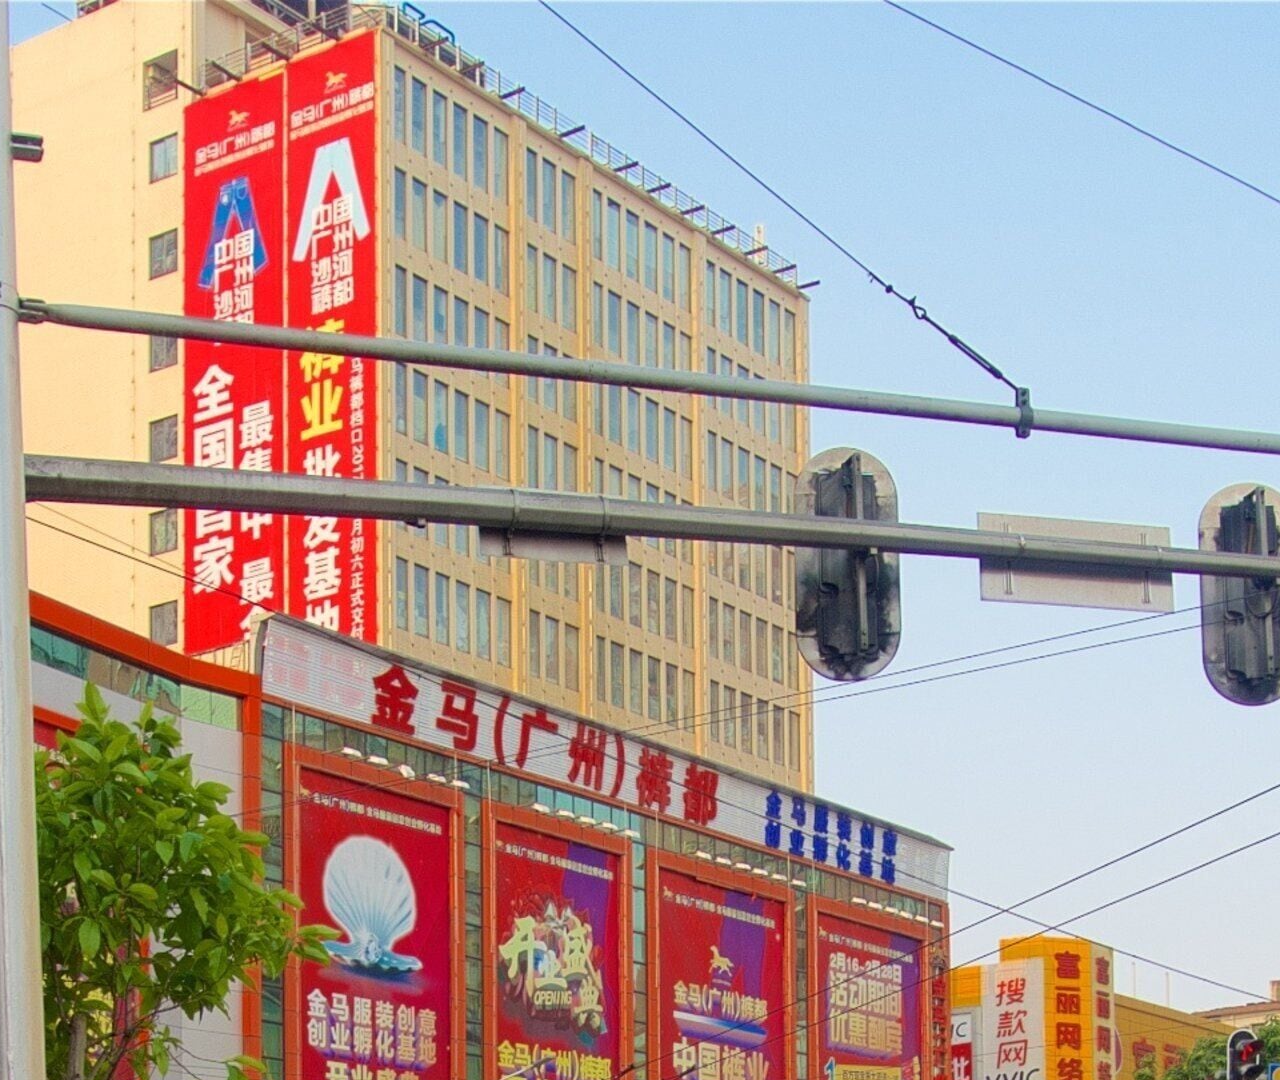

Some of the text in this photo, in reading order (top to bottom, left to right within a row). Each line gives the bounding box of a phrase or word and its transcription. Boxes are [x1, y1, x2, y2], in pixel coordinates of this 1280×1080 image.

[312, 193, 353, 229] 中国
[214, 228, 254, 264] 中国
[312, 225, 353, 260] 广州
[214, 257, 254, 293] 广州
[312, 249, 353, 287] 沙河
[312, 278, 353, 315] 裤都
[371, 663, 720, 827] 金马（广州）裤都
[307, 988, 438, 1036] 金马服装创意
[533, 990, 573, 1006] OPENING
[674, 980, 768, 1021] 金马（广州）裤都
[830, 970, 902, 1018] 活动期间
[307, 1018, 438, 1063] 创业孵化基地
[830, 1008, 902, 1054] 优惠酬宾
[995, 977, 1029, 1070] 搜款网
